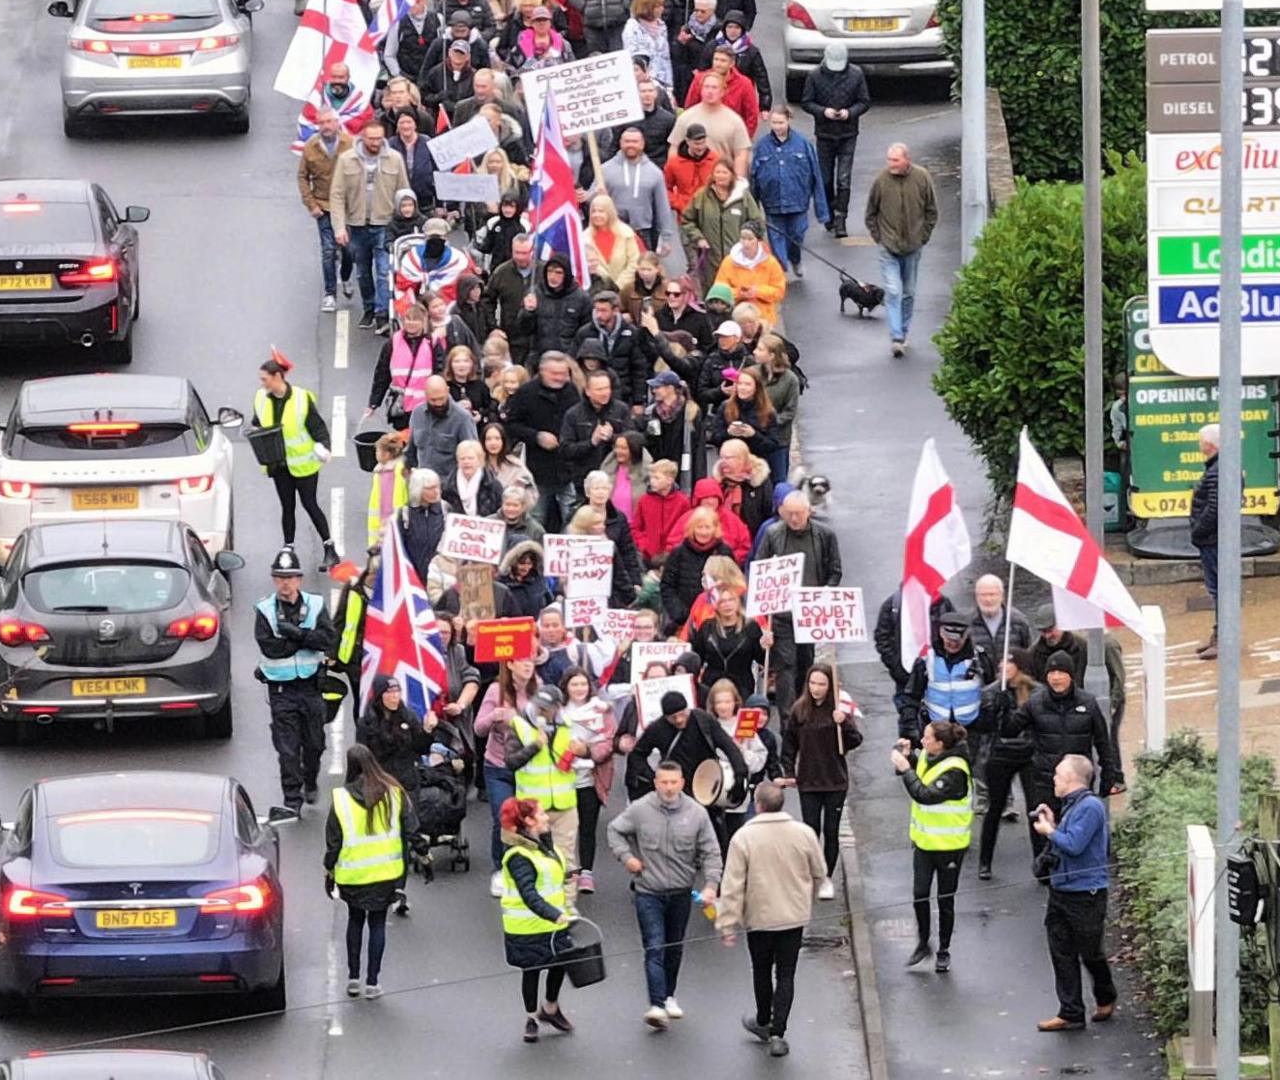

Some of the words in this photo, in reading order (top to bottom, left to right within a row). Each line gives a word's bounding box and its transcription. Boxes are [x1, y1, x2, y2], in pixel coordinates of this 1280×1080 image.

[1159, 52, 1217, 67] PETROL
[536, 57, 618, 82] PROTECT
[539, 76, 620, 99] CMMUNITY
[564, 74, 592, 86] OUR
[568, 88, 597, 100] AND
[556, 91, 625, 113] ROTECT
[1163, 101, 1216, 116] DIESEL
[561, 109, 629, 131] AMILIES
[571, 107, 600, 119] OUR
[1135, 387, 1207, 404] OPENING
[1135, 413, 1187, 426] MONDAY
[1189, 411, 1205, 423] TO
[452, 517, 505, 534] PROTECT
[460, 532, 486, 544] OUR
[448, 542, 500, 560] ELDERLY
[756, 563, 772, 576] IF
[778, 557, 798, 569] IN
[572, 569, 608, 581] MANY
[756, 570, 800, 591] DOUBT
[799, 591, 822, 602] IF
[831, 591, 854, 601] IN
[759, 599, 789, 613] OUT
[802, 604, 856, 619] DOUBT
[797, 617, 827, 628] KEEP
[495, 645, 514, 657] NO
[639, 644, 687, 656] PROTECT
[79, 680, 110, 692] VE64
[102, 913, 139, 926] BN67
